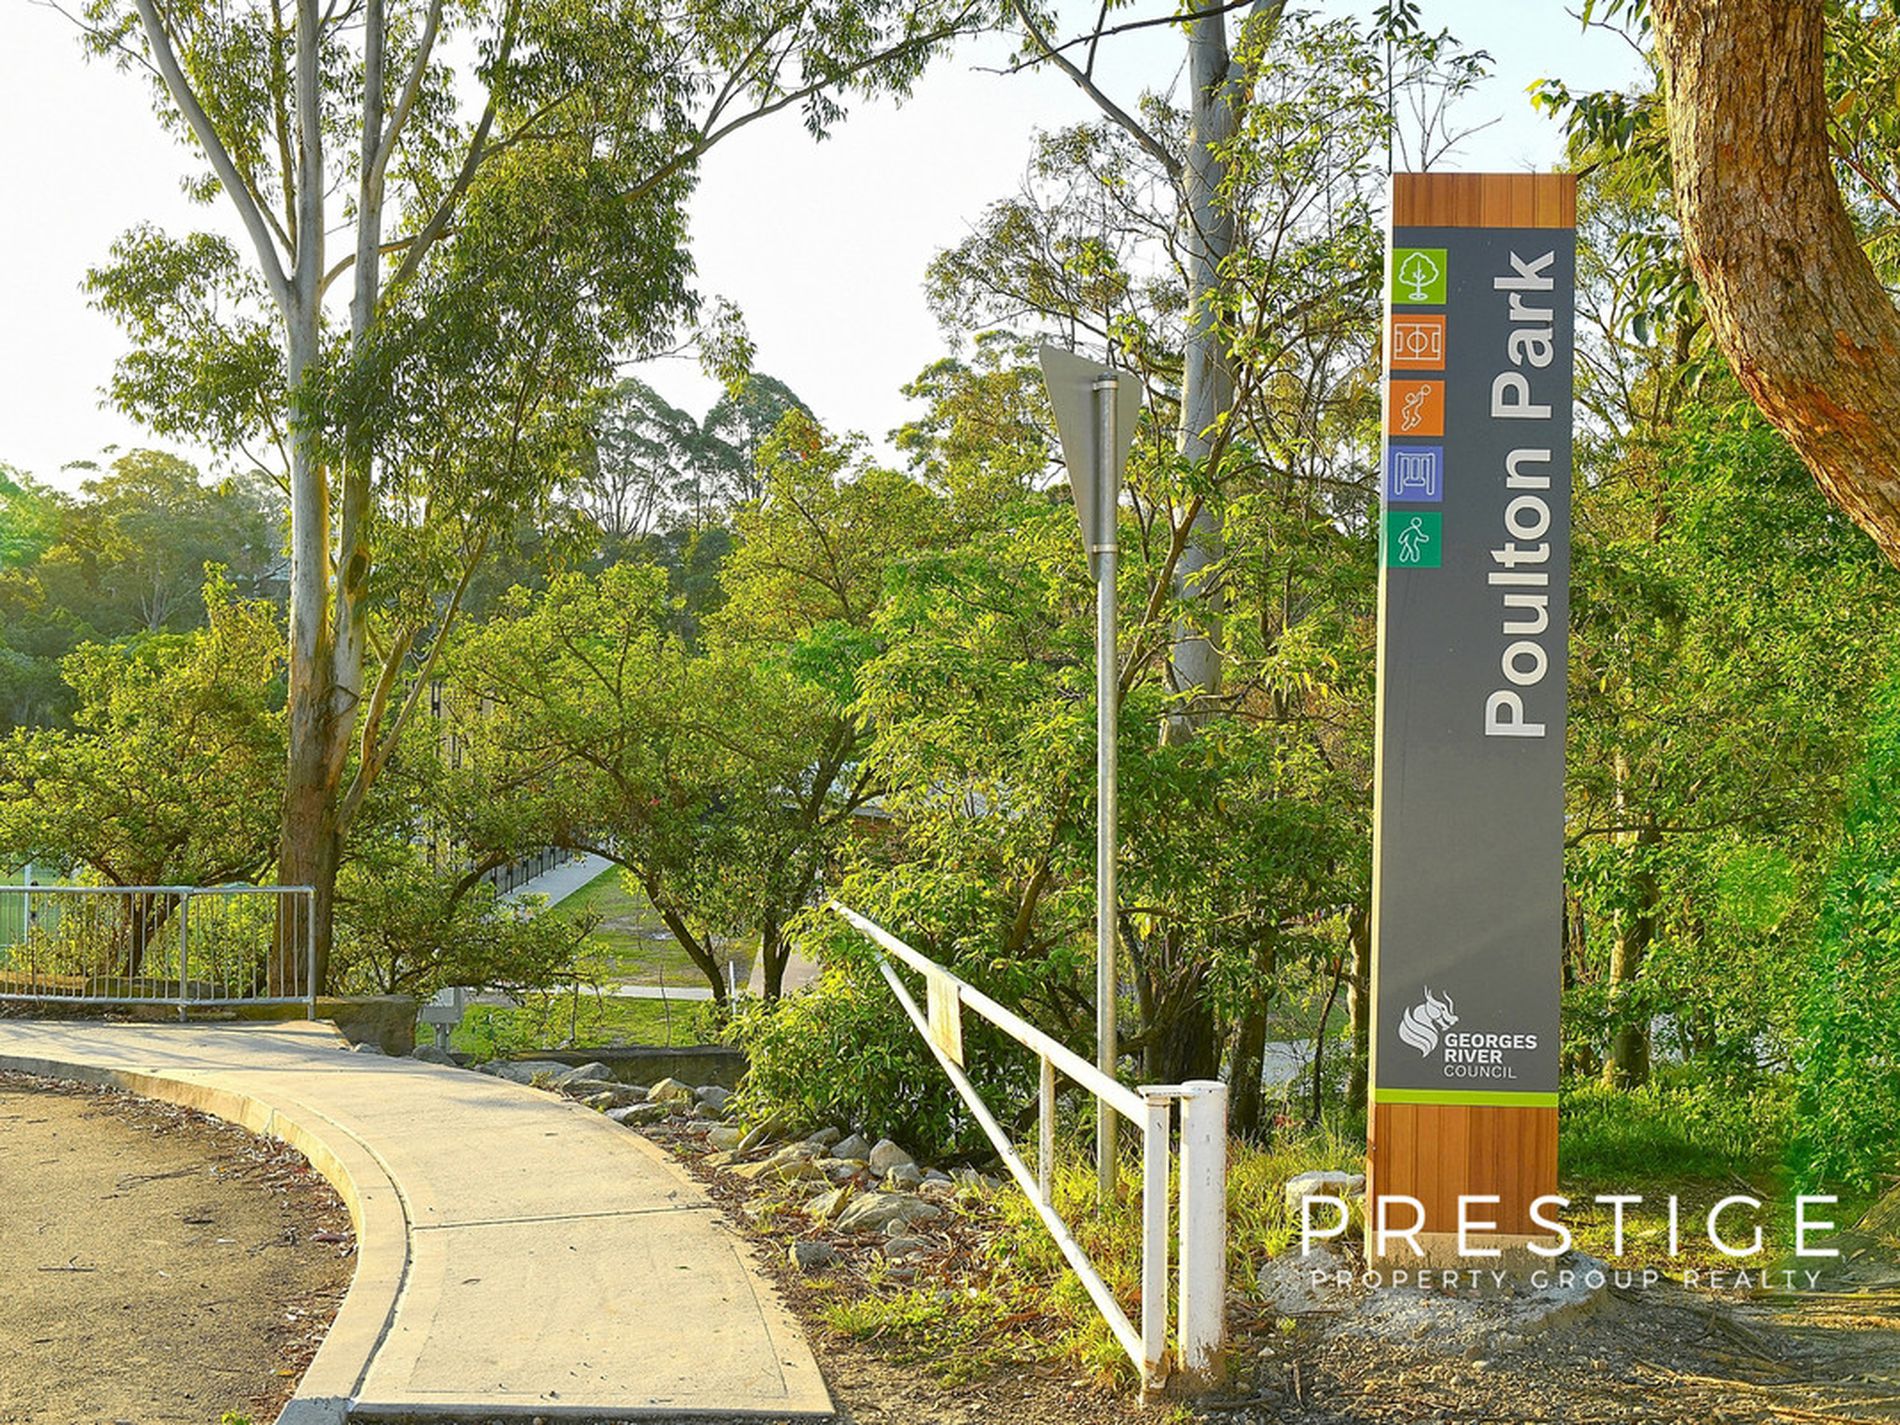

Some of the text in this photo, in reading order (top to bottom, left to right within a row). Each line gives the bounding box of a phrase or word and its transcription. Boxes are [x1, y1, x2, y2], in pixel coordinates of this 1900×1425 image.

[1485, 250, 1556, 738] Poulton Park
[1444, 1033, 1537, 1049] GEORGES
[1444, 1050, 1502, 1064] RIVER
[1443, 1065, 1517, 1079] COUNCIL
